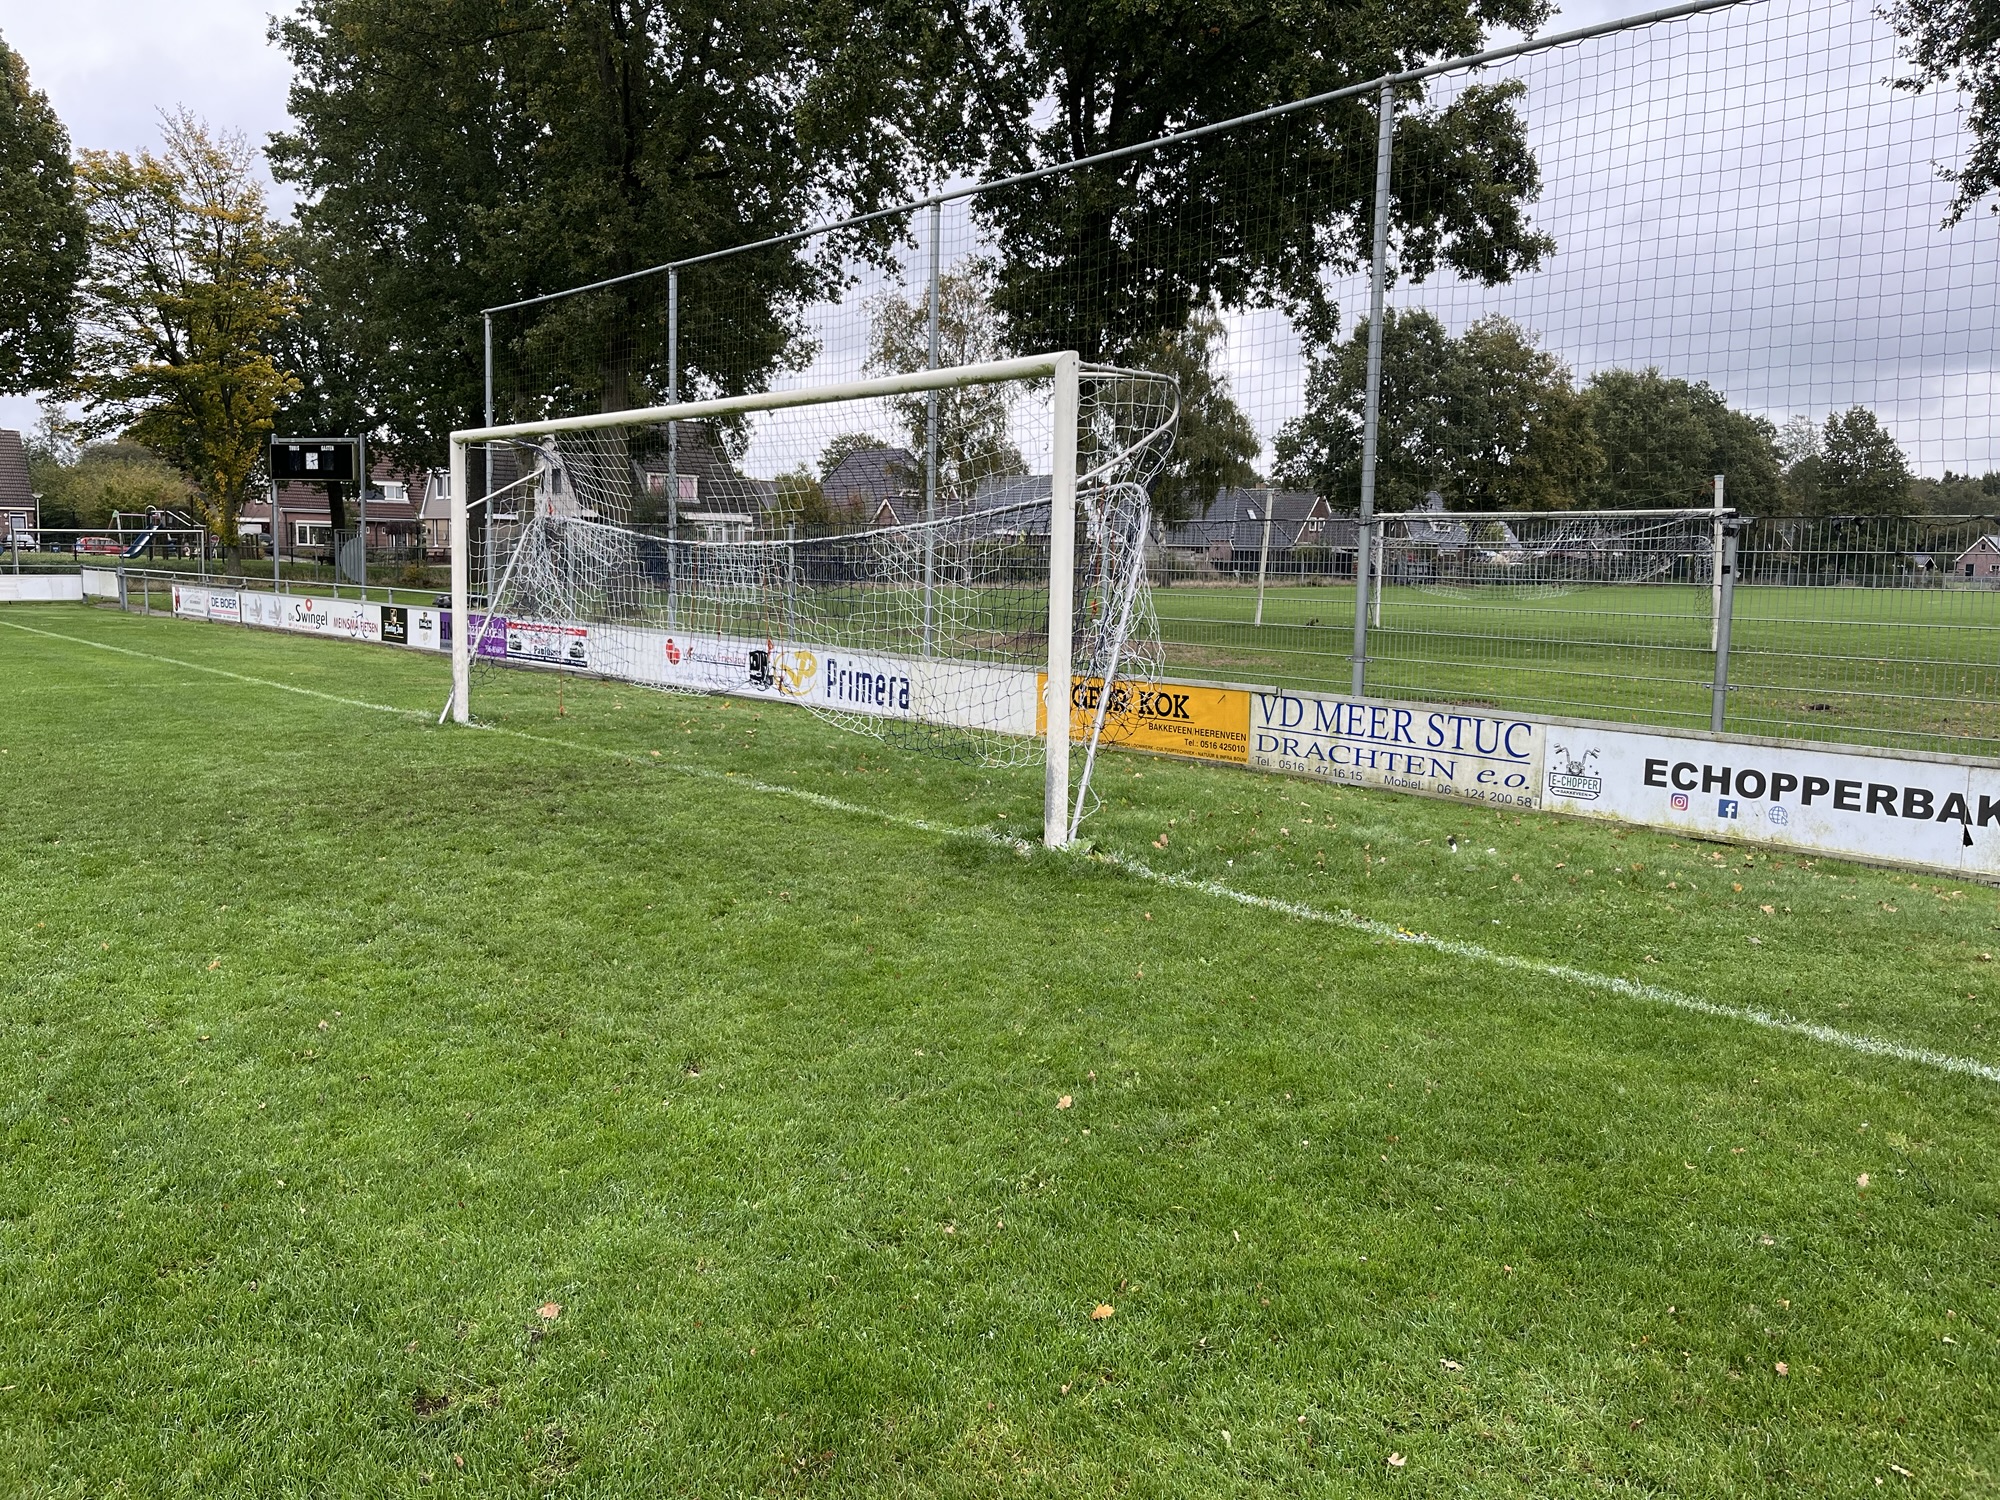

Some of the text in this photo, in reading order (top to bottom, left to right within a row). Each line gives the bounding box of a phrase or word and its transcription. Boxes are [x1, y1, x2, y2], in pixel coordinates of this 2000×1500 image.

[211, 597, 219, 607] DE
[221, 598, 237, 609] BOER
[288, 612, 294, 622] De
[295, 604, 328, 630] Swingel
[333, 617, 379, 633] MEINSMA FIETSEN
[827, 658, 910, 710] Primera
[1139, 690, 1190, 720] KOK
[1260, 694, 1532, 758] VD MEER STUC
[1200, 740, 1218, 750] 0516
[1219, 743, 1246, 754] 425010
[1256, 733, 1531, 790] DRACHTEN e.o.
[1279, 760, 1305, 772] 0516
[1315, 765, 1328, 775] 47
[1333, 768, 1345, 778] 16
[1350, 771, 1363, 781] 15
[1437, 784, 1451, 794] 06
[1464, 788, 1485, 800] 124
[1490, 792, 1512, 804] 200
[1516, 797, 1532, 808] 58
[1551, 775, 1599, 791] E-CHOPPER
[1643, 757, 2000, 828] ECHOPPERBAK
